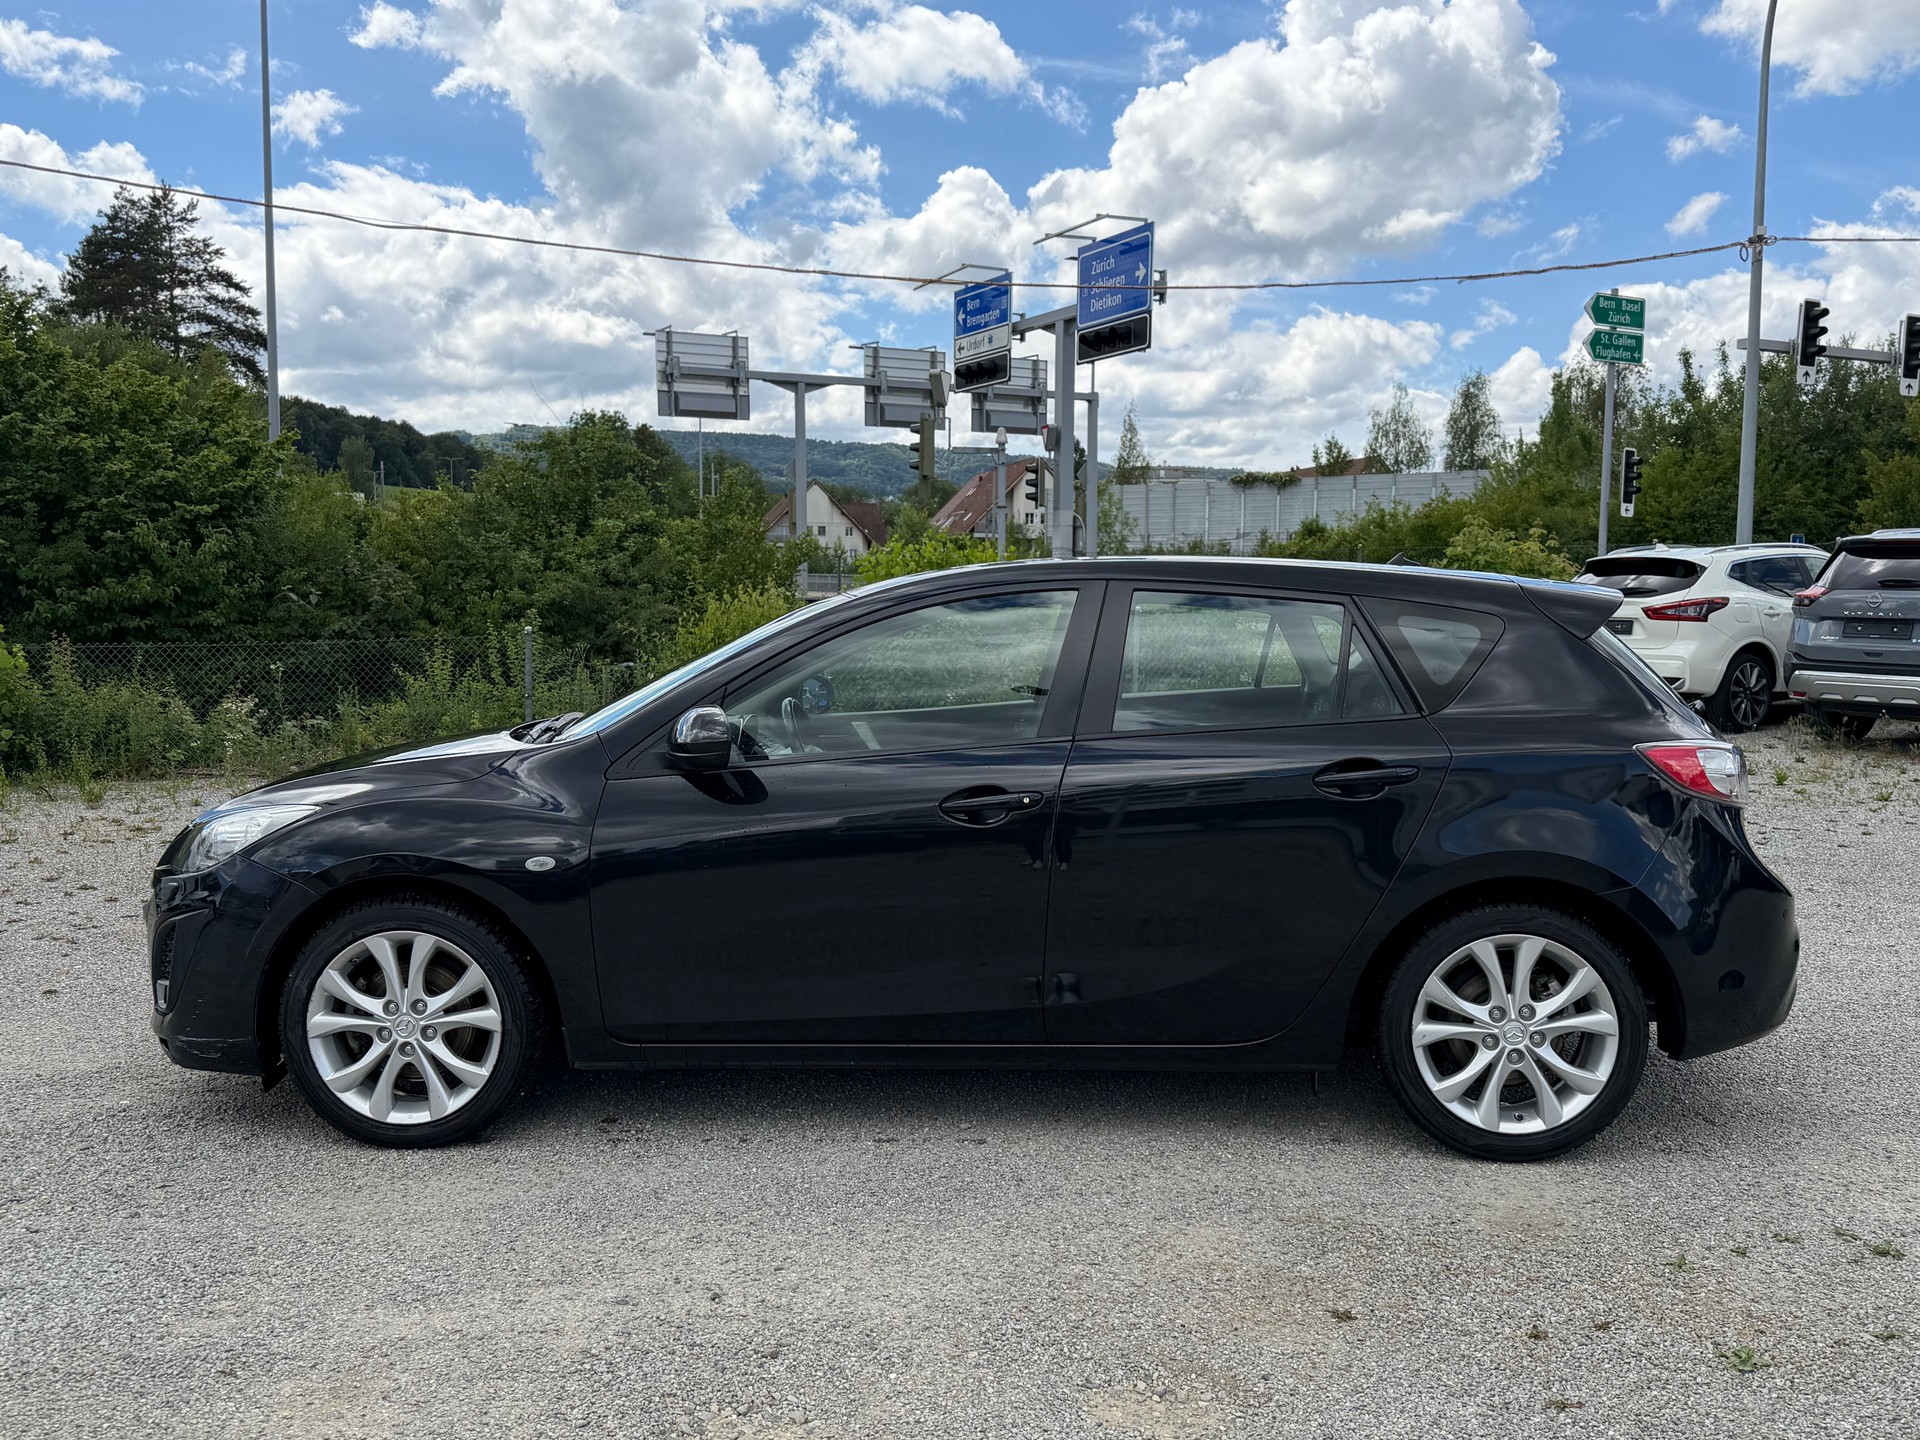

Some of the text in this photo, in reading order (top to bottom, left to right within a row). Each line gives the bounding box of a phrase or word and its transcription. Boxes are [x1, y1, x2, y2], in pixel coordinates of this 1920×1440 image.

[1092, 255, 1114, 274] Zürich
[1091, 275, 1125, 294] Schlieren
[967, 299, 980, 311] Bern
[1091, 294, 1121, 312] Dietikon
[1599, 297, 1640, 312] Bern Basel
[967, 309, 1000, 327] Bremgarten
[1608, 312, 1630, 324] Zürich
[966, 336, 986, 352] Urdorf
[1600, 333, 1636, 347] St. Gallen
[1596, 346, 1631, 360] Flughafen
